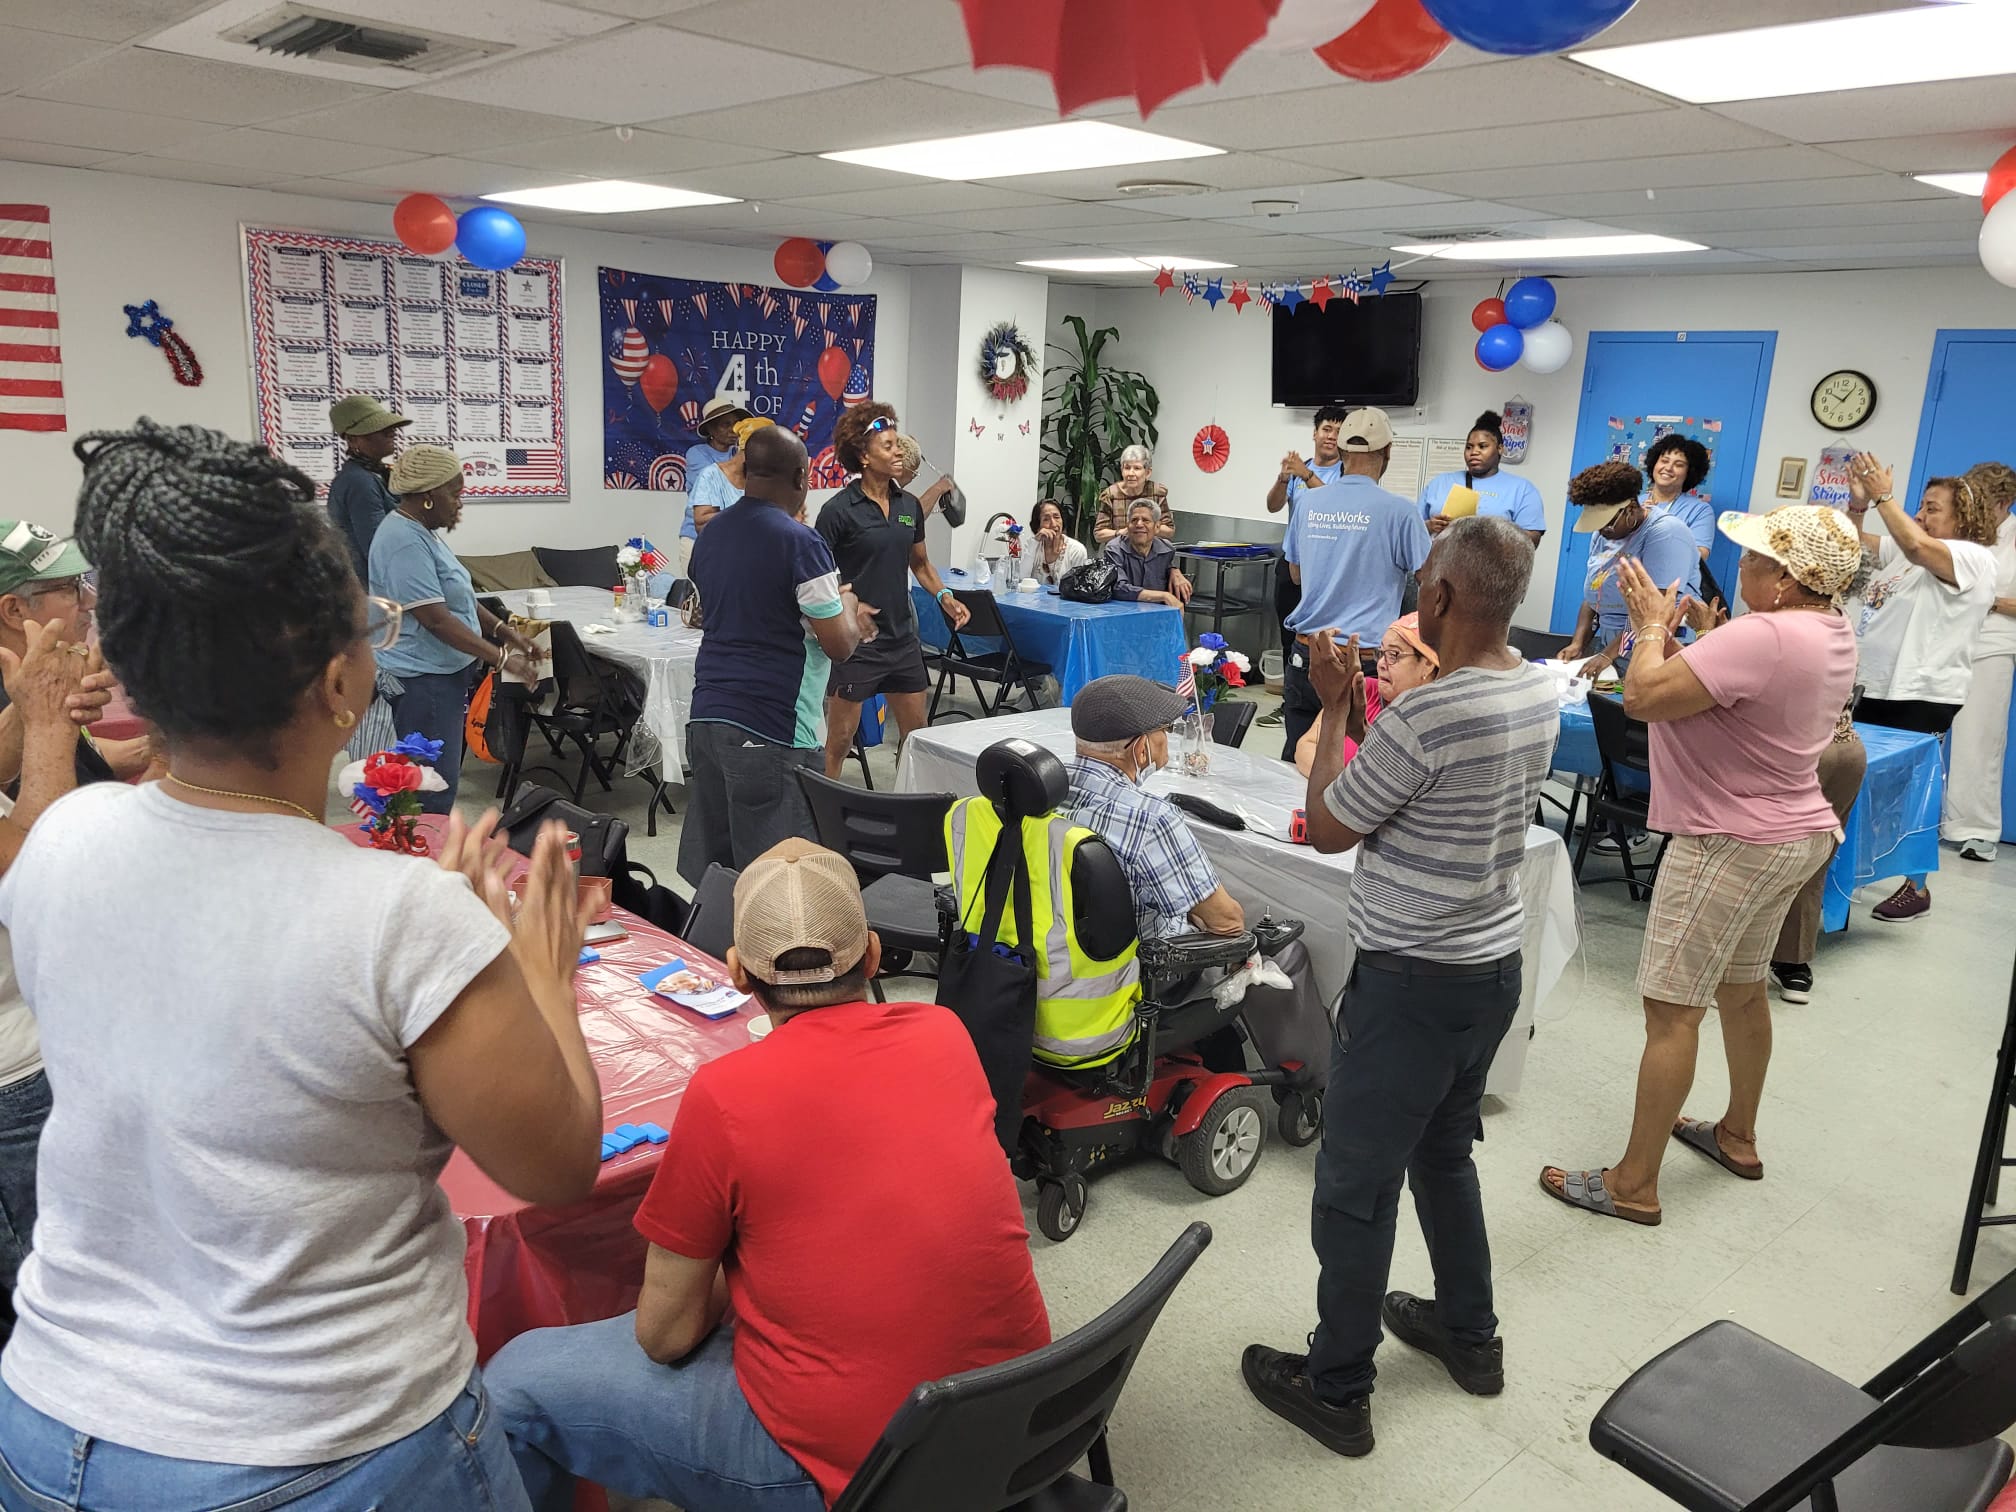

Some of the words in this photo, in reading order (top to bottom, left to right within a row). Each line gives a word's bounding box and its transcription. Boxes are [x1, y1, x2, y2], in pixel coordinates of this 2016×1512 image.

[711, 330, 787, 353] HAPPY
[1858, 388, 1864, 396] 2
[753, 395, 783, 415] OF
[1821, 396, 1827, 404] 9
[1860, 397, 1866, 405] 3
[1837, 414, 1843, 422] 6
[1847, 413, 1853, 421] 5
[1502, 421, 1527, 438] Stars
[1502, 436, 1526, 451] tripes
[1819, 469, 1849, 485] Star
[1812, 485, 1851, 504] Stripe
[1307, 509, 1371, 524] BronxWorks
[1103, 1095, 1147, 1116] Jazzy
